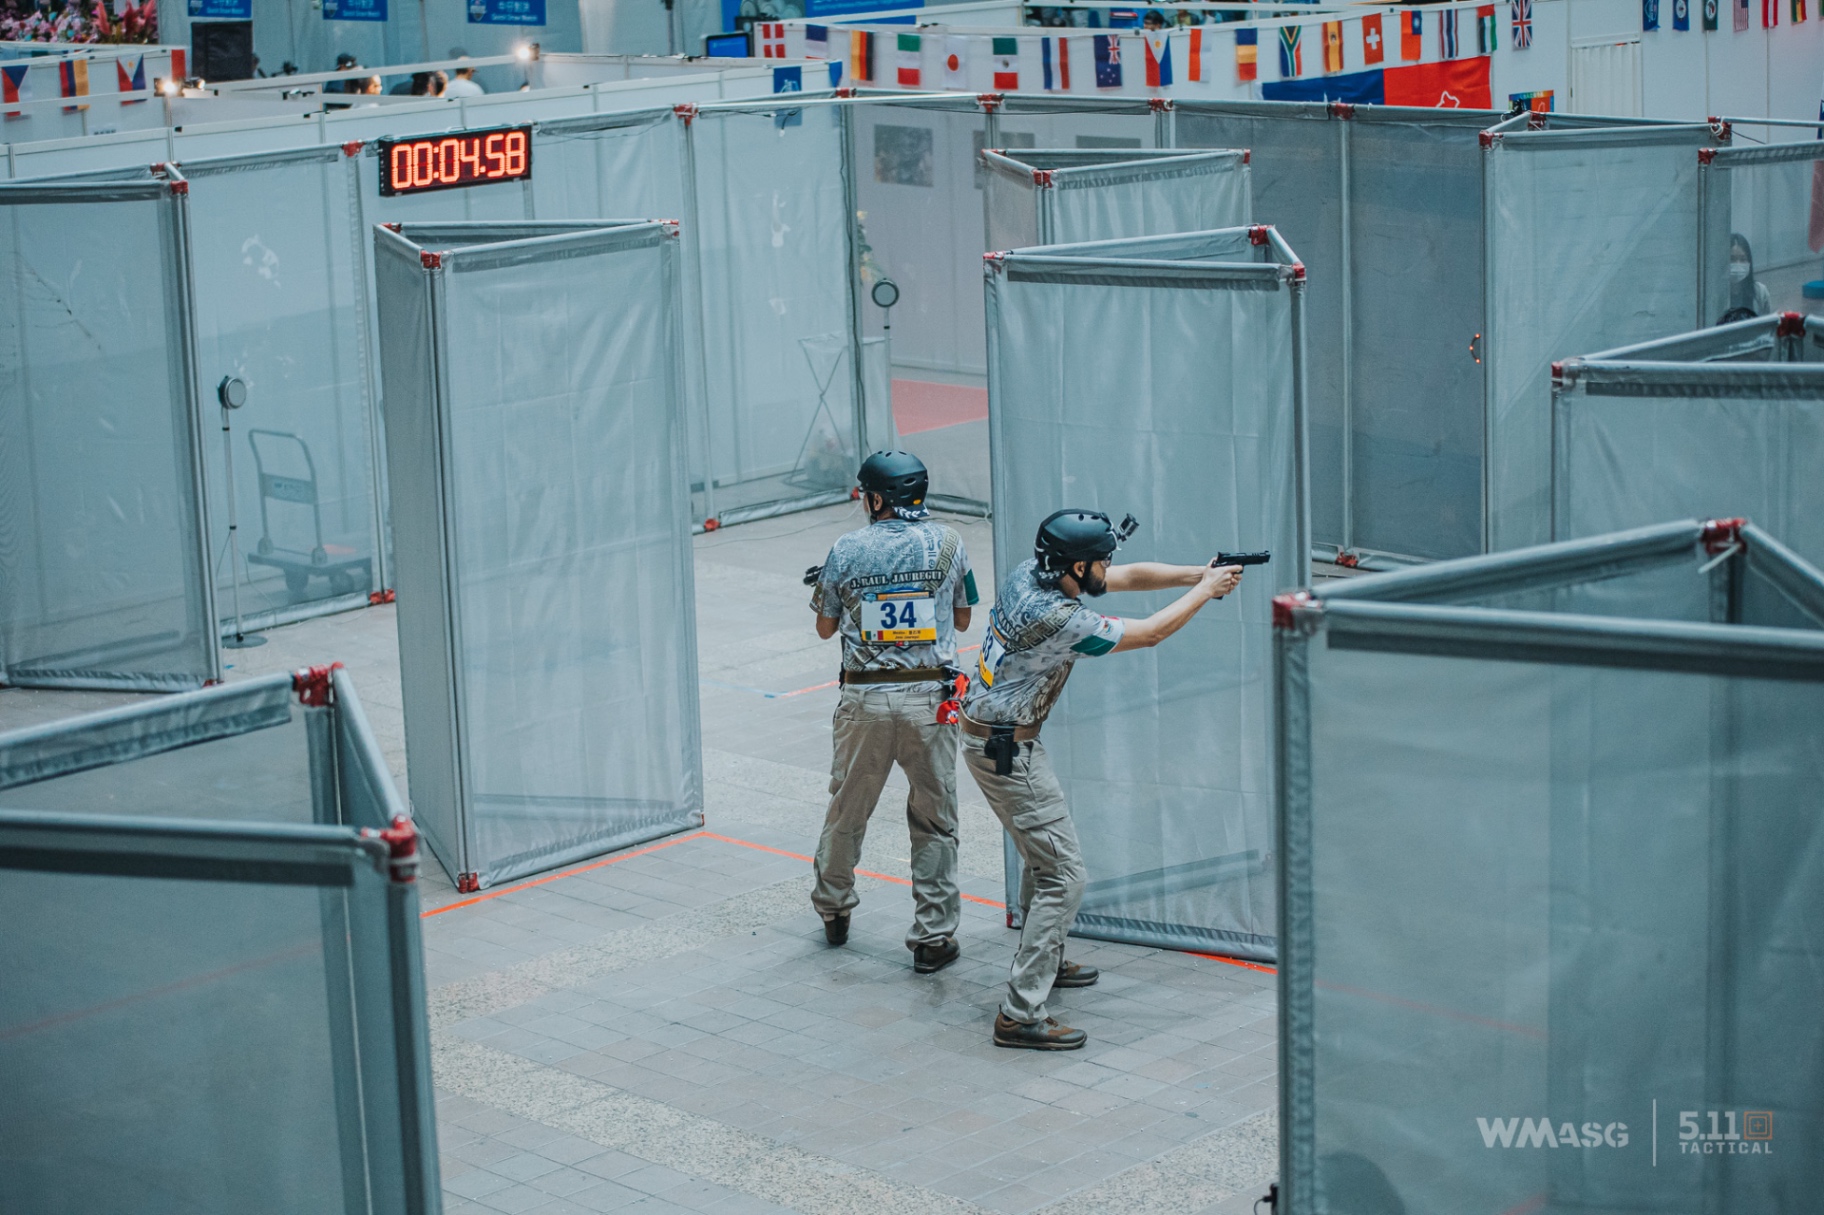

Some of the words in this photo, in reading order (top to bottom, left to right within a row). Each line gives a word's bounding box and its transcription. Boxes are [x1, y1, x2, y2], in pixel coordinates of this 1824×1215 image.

[391, 131, 526, 189] 00:04.58
[851, 578, 860, 588] J.
[861, 575, 889, 586] RAUL
[892, 570, 943, 583] JAUREGUI
[880, 601, 917, 629] 34
